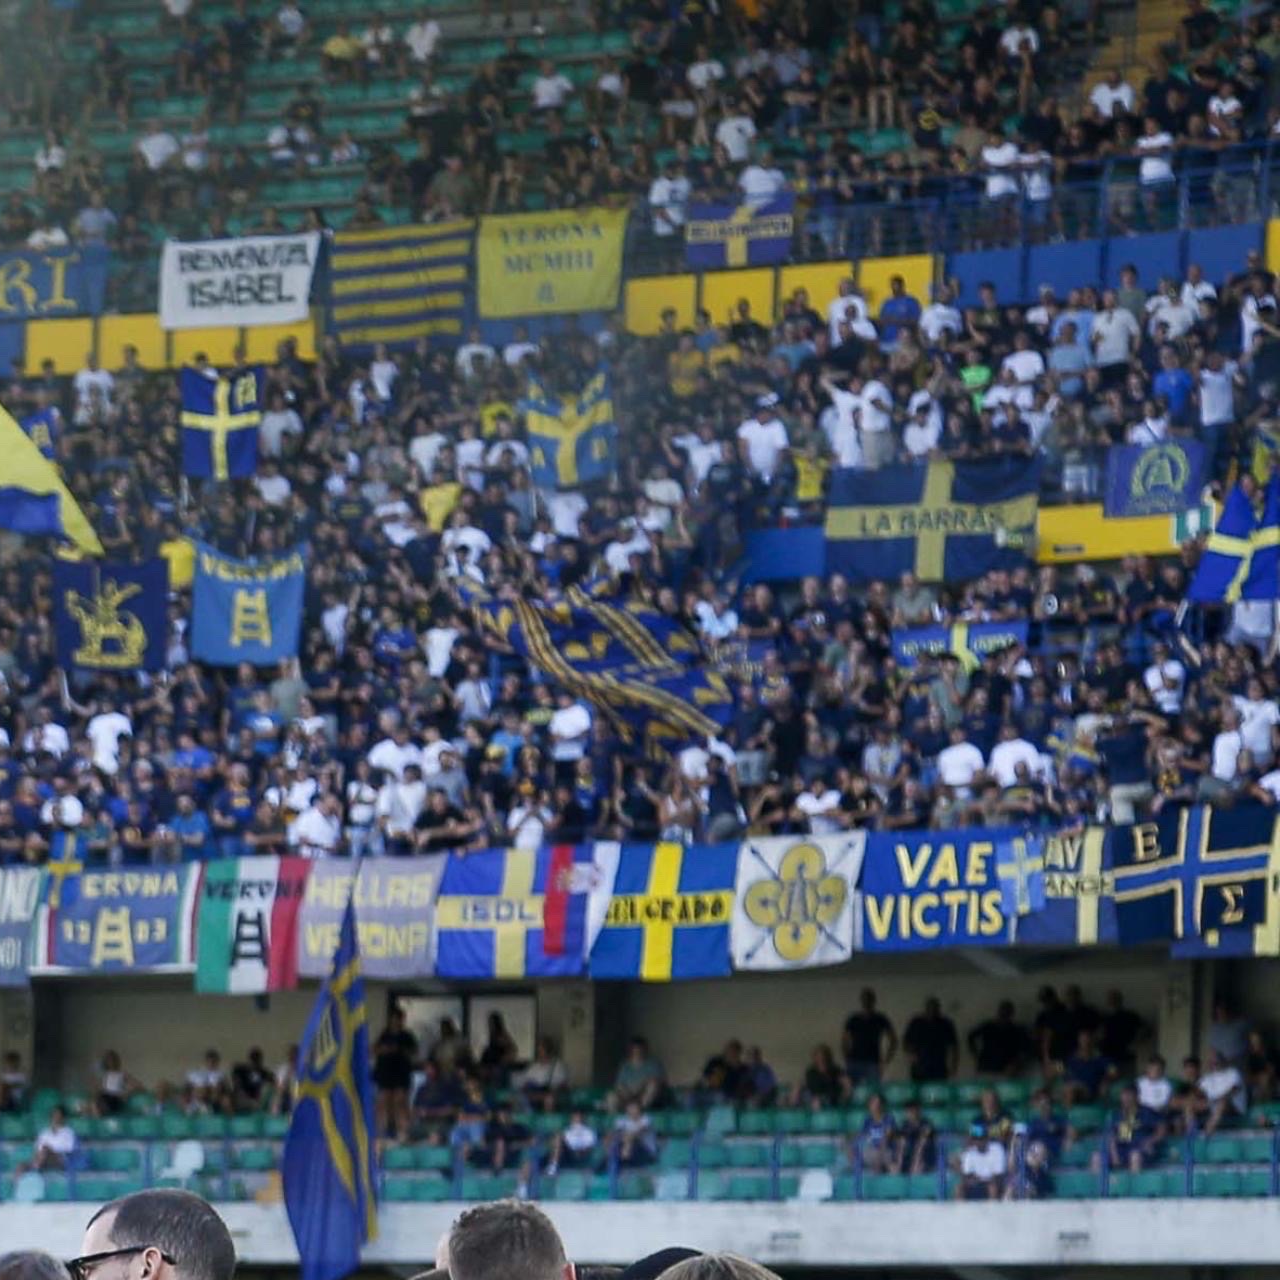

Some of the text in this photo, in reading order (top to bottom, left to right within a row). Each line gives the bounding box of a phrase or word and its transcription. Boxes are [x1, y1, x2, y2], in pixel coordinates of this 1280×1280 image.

[188, 272, 296, 308] ISABEL
[81, 870, 179, 898] ERONA
[895, 842, 994, 889] VAE
[864, 891, 1004, 940] VICTIS
